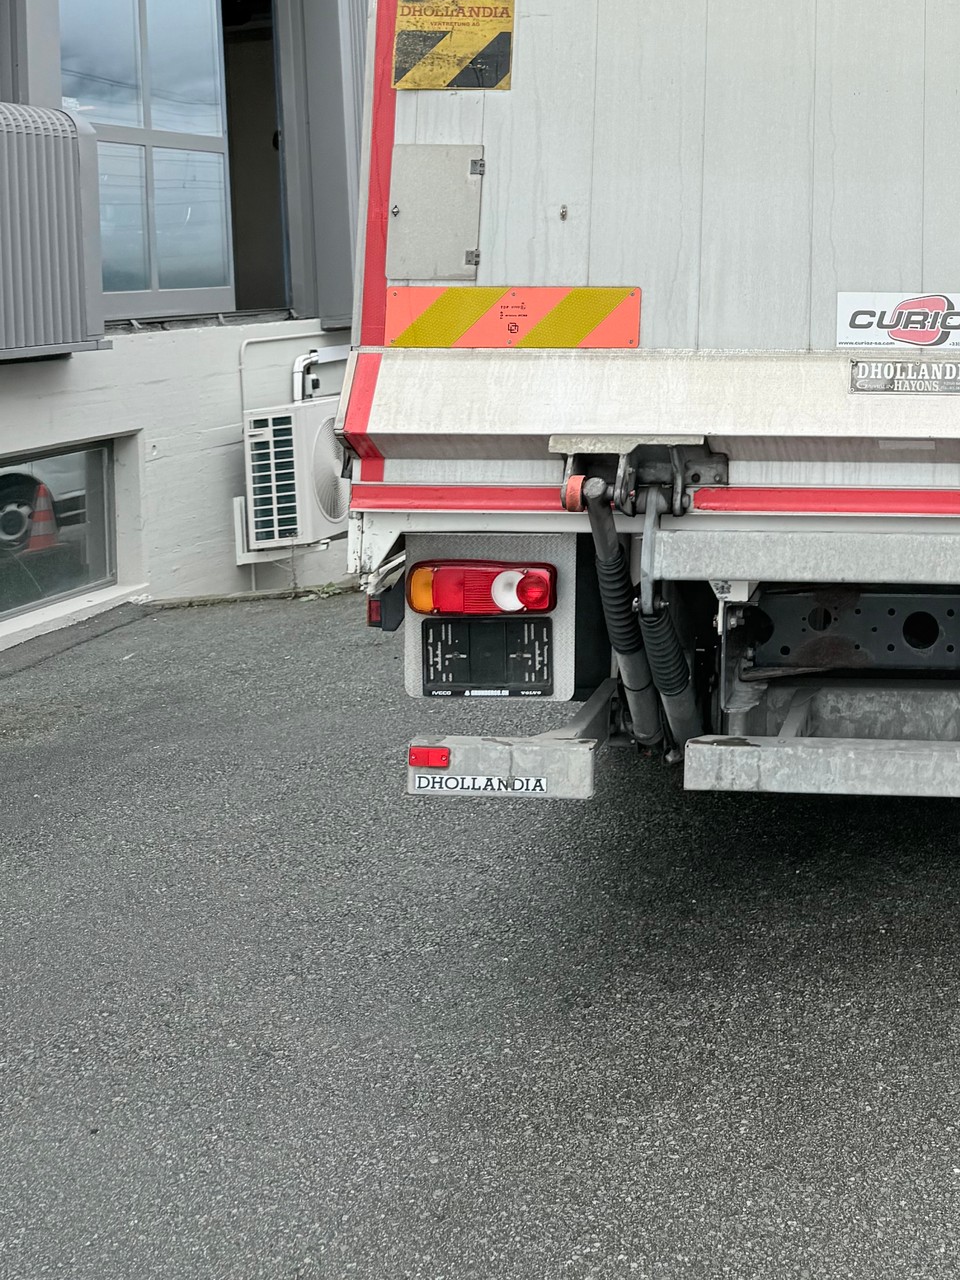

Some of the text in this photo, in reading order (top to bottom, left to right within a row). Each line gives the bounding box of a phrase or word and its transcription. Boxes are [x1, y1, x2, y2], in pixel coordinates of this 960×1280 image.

[400, 5, 511, 19] DHOLLANDIA
[893, 380, 939, 391] HAYONS
[416, 775, 545, 791] DHOLLANDIA
